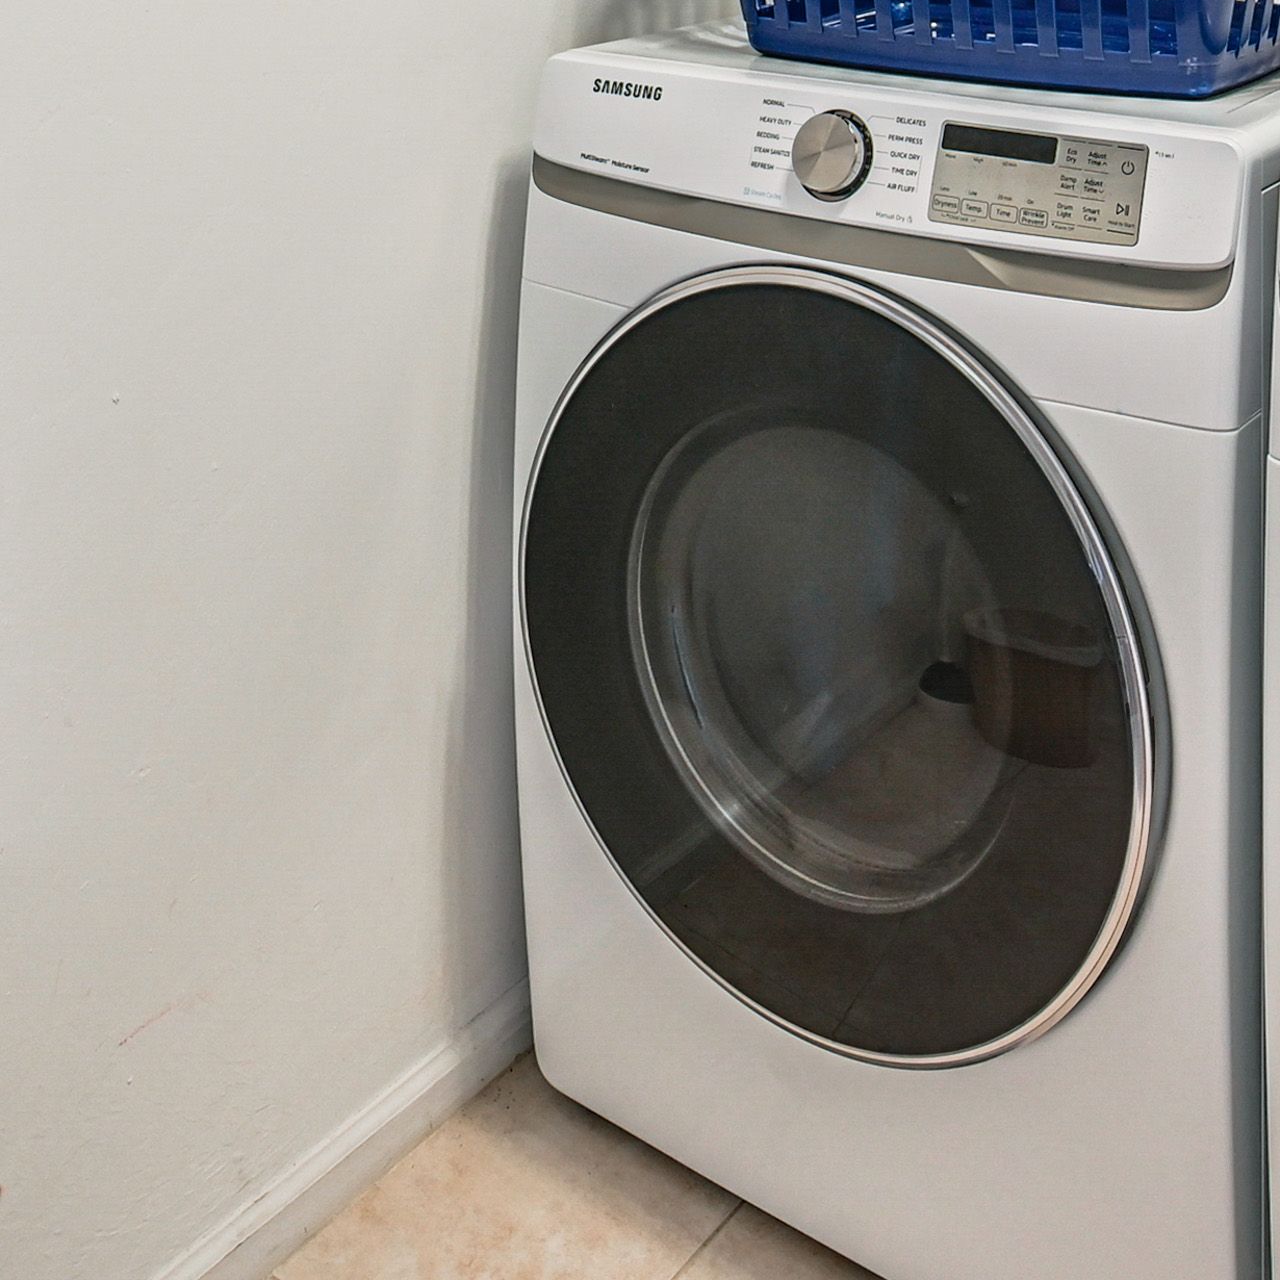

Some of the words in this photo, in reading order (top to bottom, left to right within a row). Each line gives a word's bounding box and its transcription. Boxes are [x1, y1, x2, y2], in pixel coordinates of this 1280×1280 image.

[593, 78, 664, 101] SAMSUNG
[777, 118, 792, 126] DUTY
[896, 116, 927, 127] DELICATES
[756, 130, 780, 140] BEDDING
[888, 133, 904, 143] PERM
[904, 136, 923, 145] PRESS
[890, 150, 907, 159] QUICK
[908, 152, 920, 161] DRY
[905, 169, 918, 177] DRY
[897, 183, 915, 193] FLUFF
